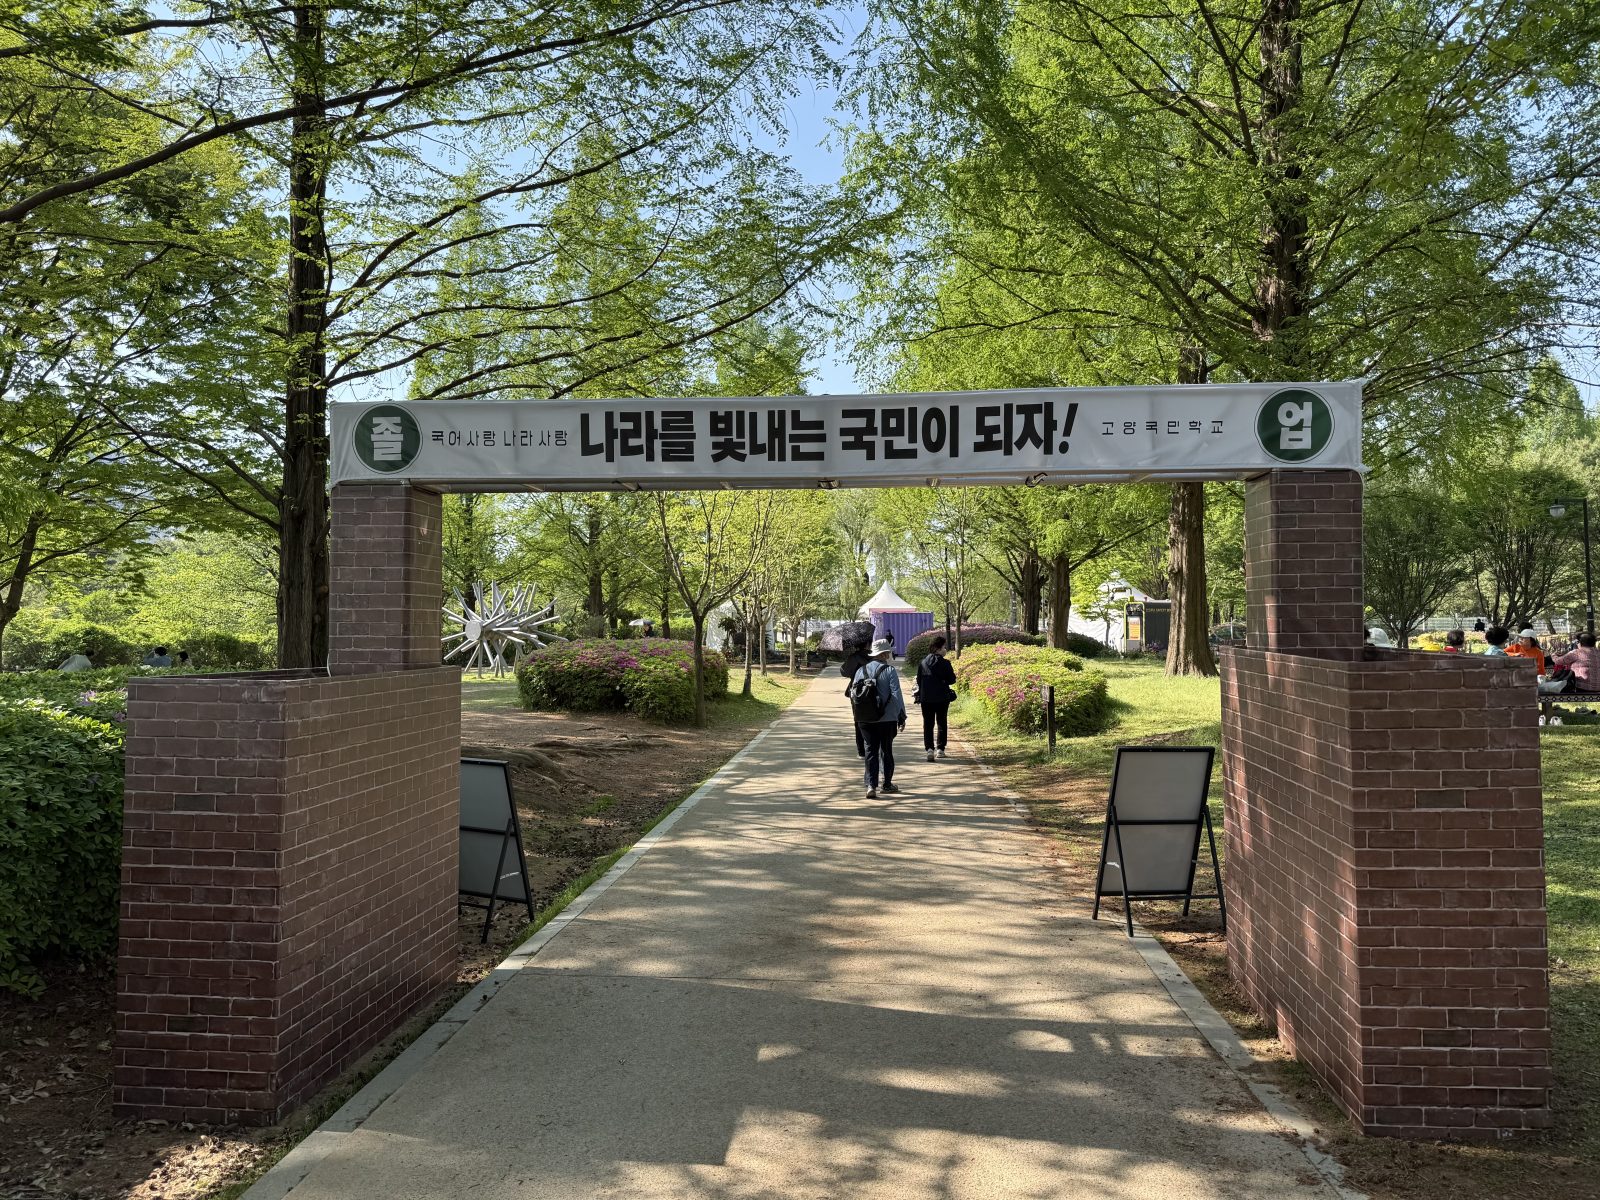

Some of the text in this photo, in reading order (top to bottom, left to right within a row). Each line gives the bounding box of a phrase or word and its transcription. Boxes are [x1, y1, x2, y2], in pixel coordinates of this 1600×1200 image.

[370, 416, 404, 461] 졸
[431, 430, 568, 447] 국어사랑 나라사랑
[580, 402, 1079, 463] 나라를 빛내는 국민이 되자!
[1101, 420, 1224, 436] 고양국민학교
[1278, 401, 1313, 450] 업
